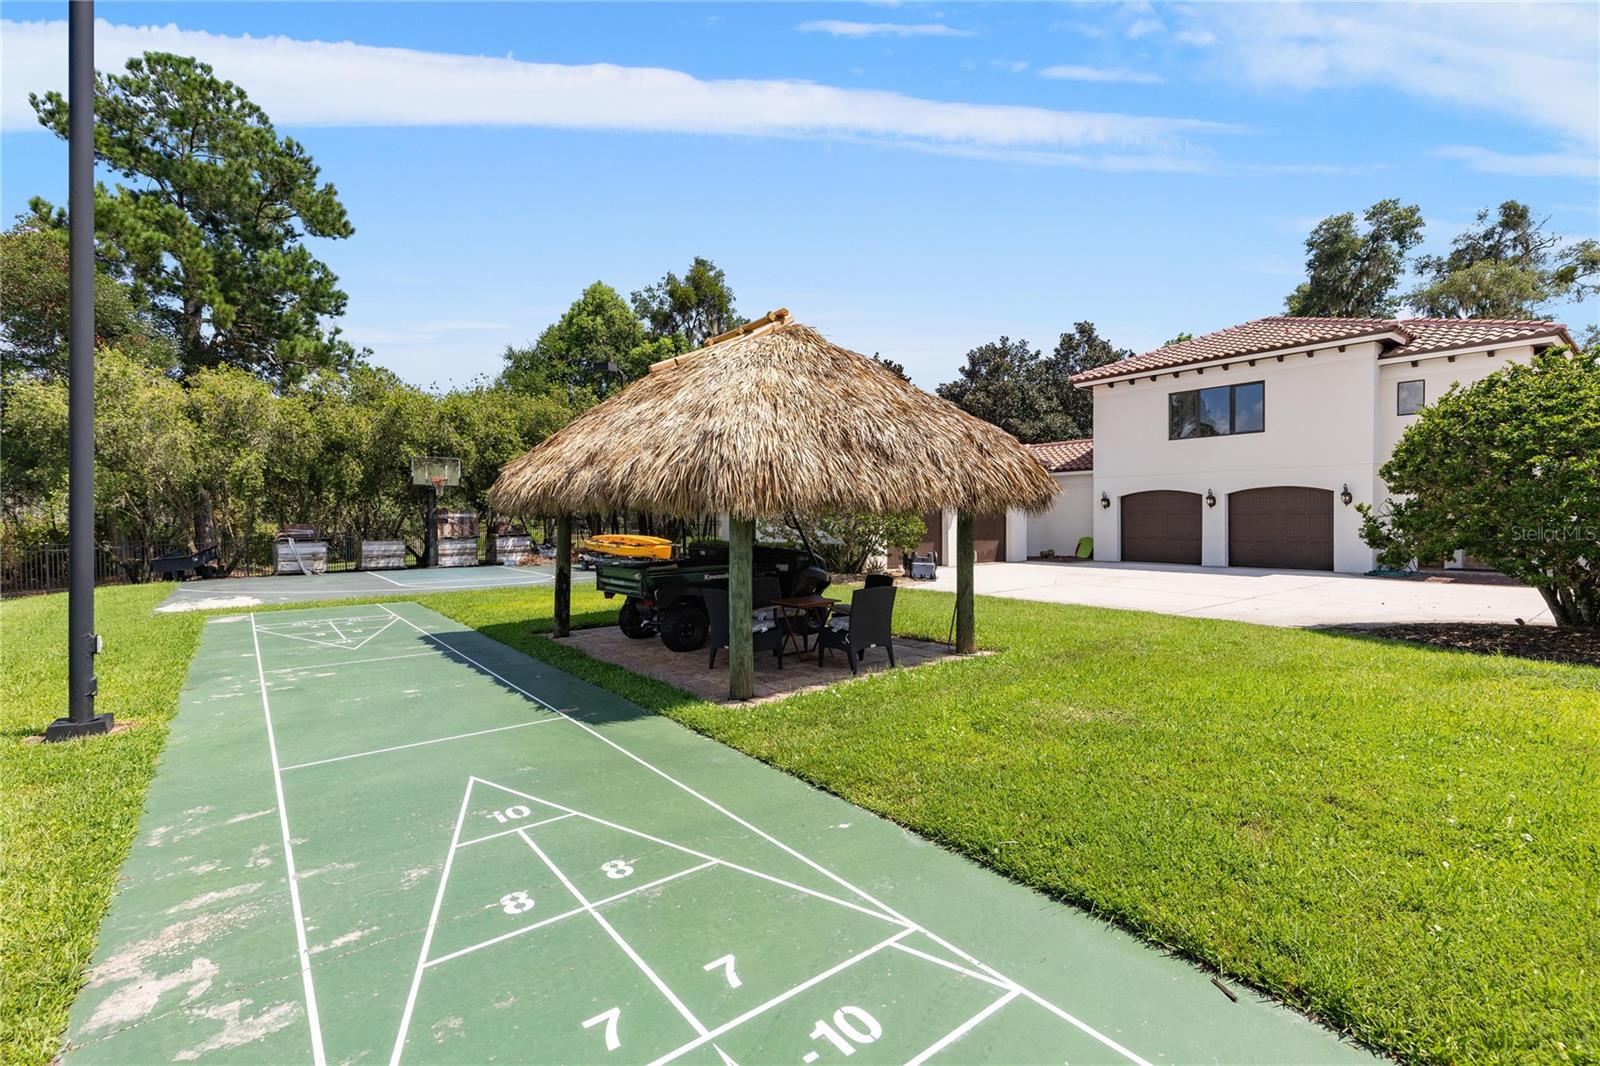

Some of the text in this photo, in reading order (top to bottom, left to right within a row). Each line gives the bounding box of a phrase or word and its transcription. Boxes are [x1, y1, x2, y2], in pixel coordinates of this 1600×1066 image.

[486, 805, 532, 823] 10
[601, 859, 635, 879] 8
[499, 890, 536, 914] 8
[703, 953, 743, 989] 7
[581, 1006, 622, 1052] 7
[802, 1004, 884, 1064] -10
